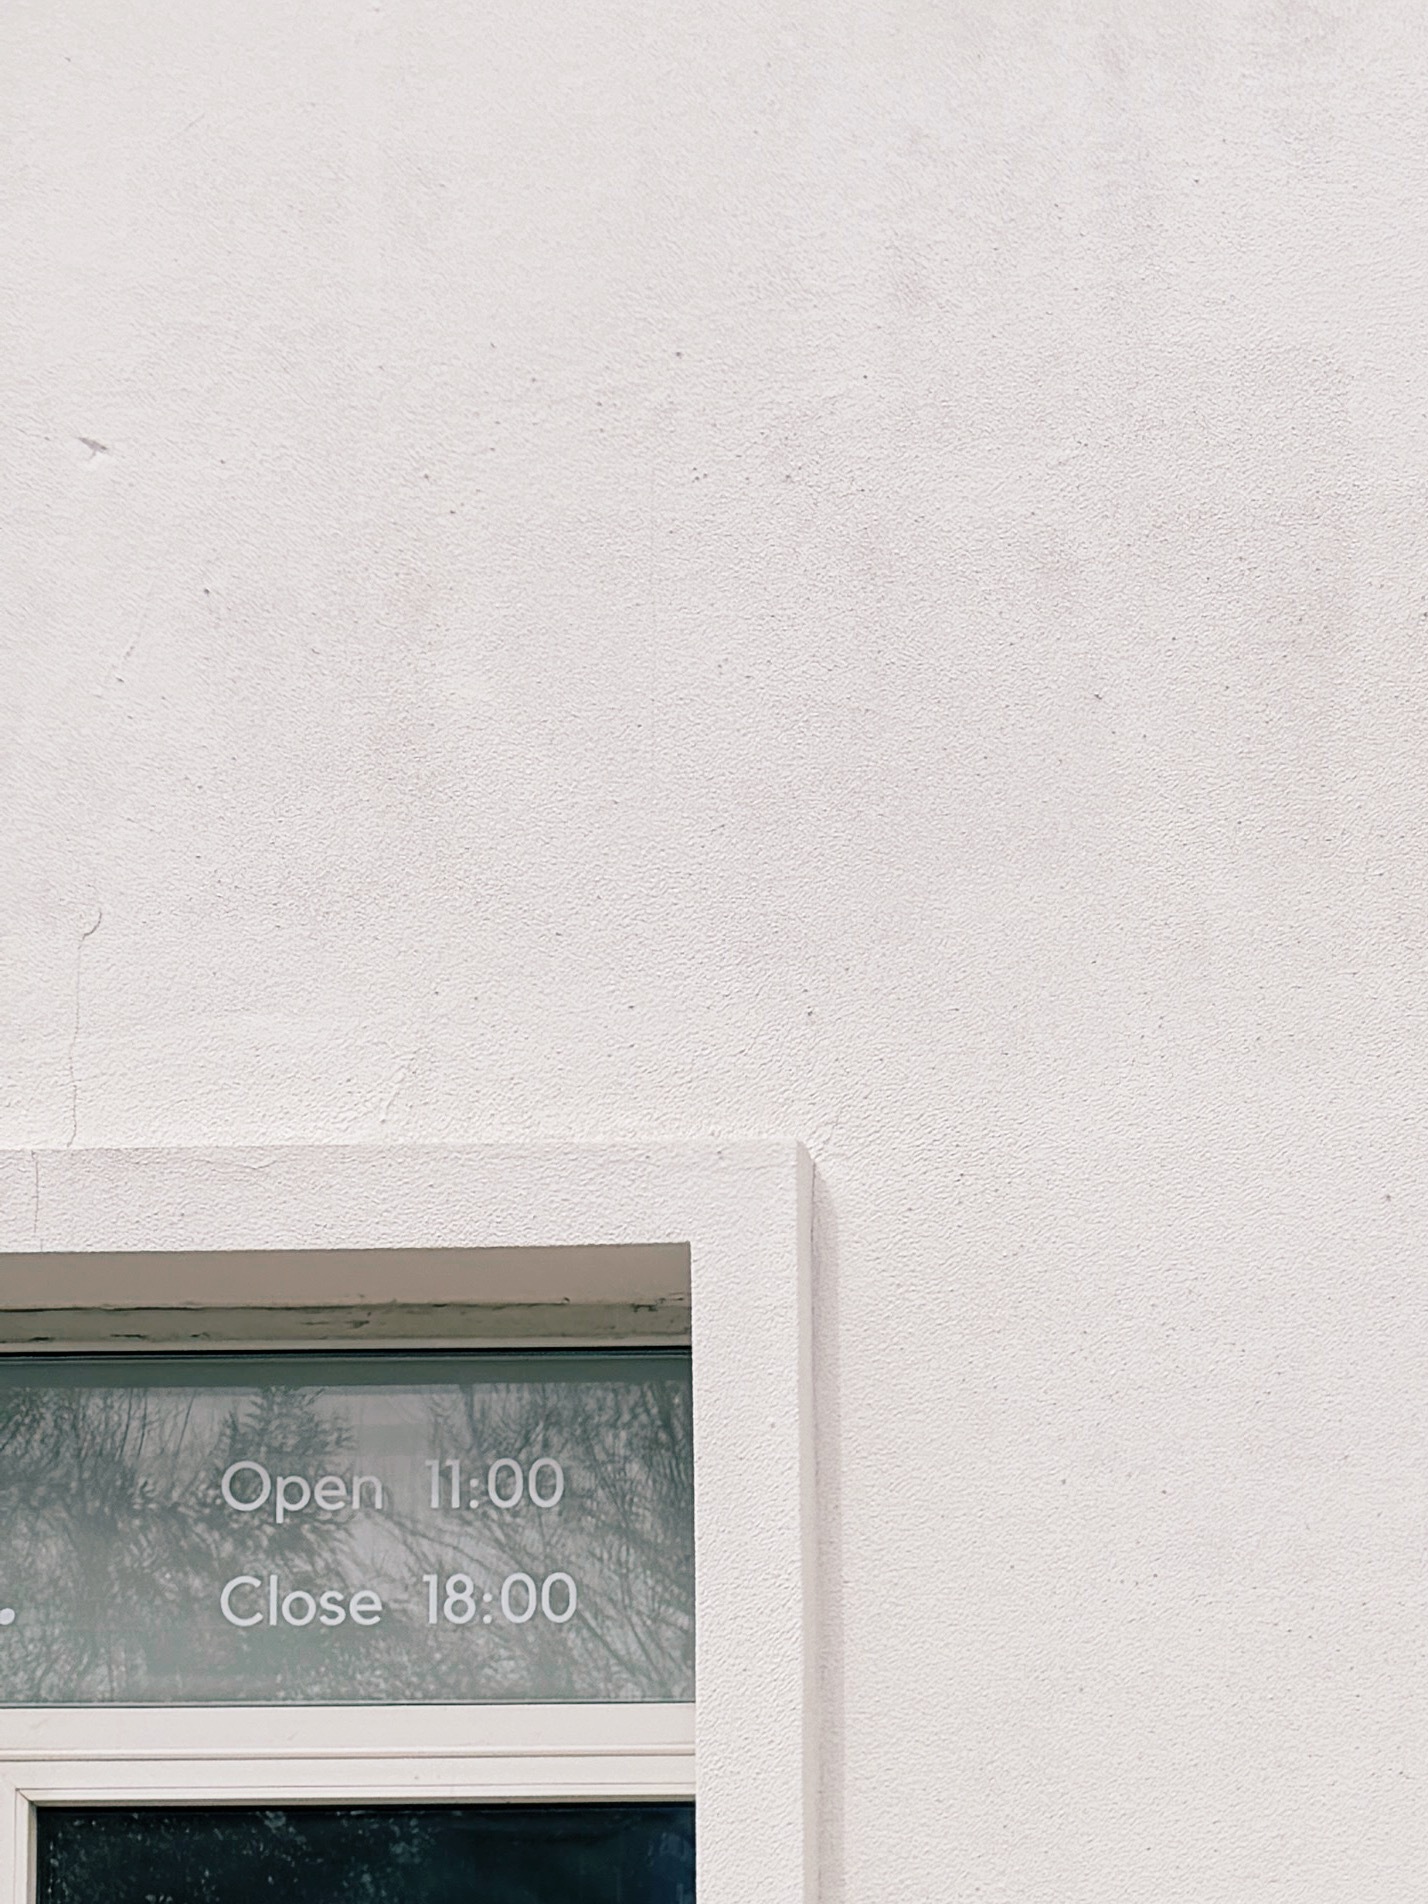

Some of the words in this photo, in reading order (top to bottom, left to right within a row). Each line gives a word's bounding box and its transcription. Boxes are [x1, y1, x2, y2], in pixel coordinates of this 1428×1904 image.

[221, 1461, 384, 1523] Open
[428, 1457, 565, 1510] 11:00
[219, 1575, 384, 1627] Close
[422, 1572, 579, 1625] 18:00
